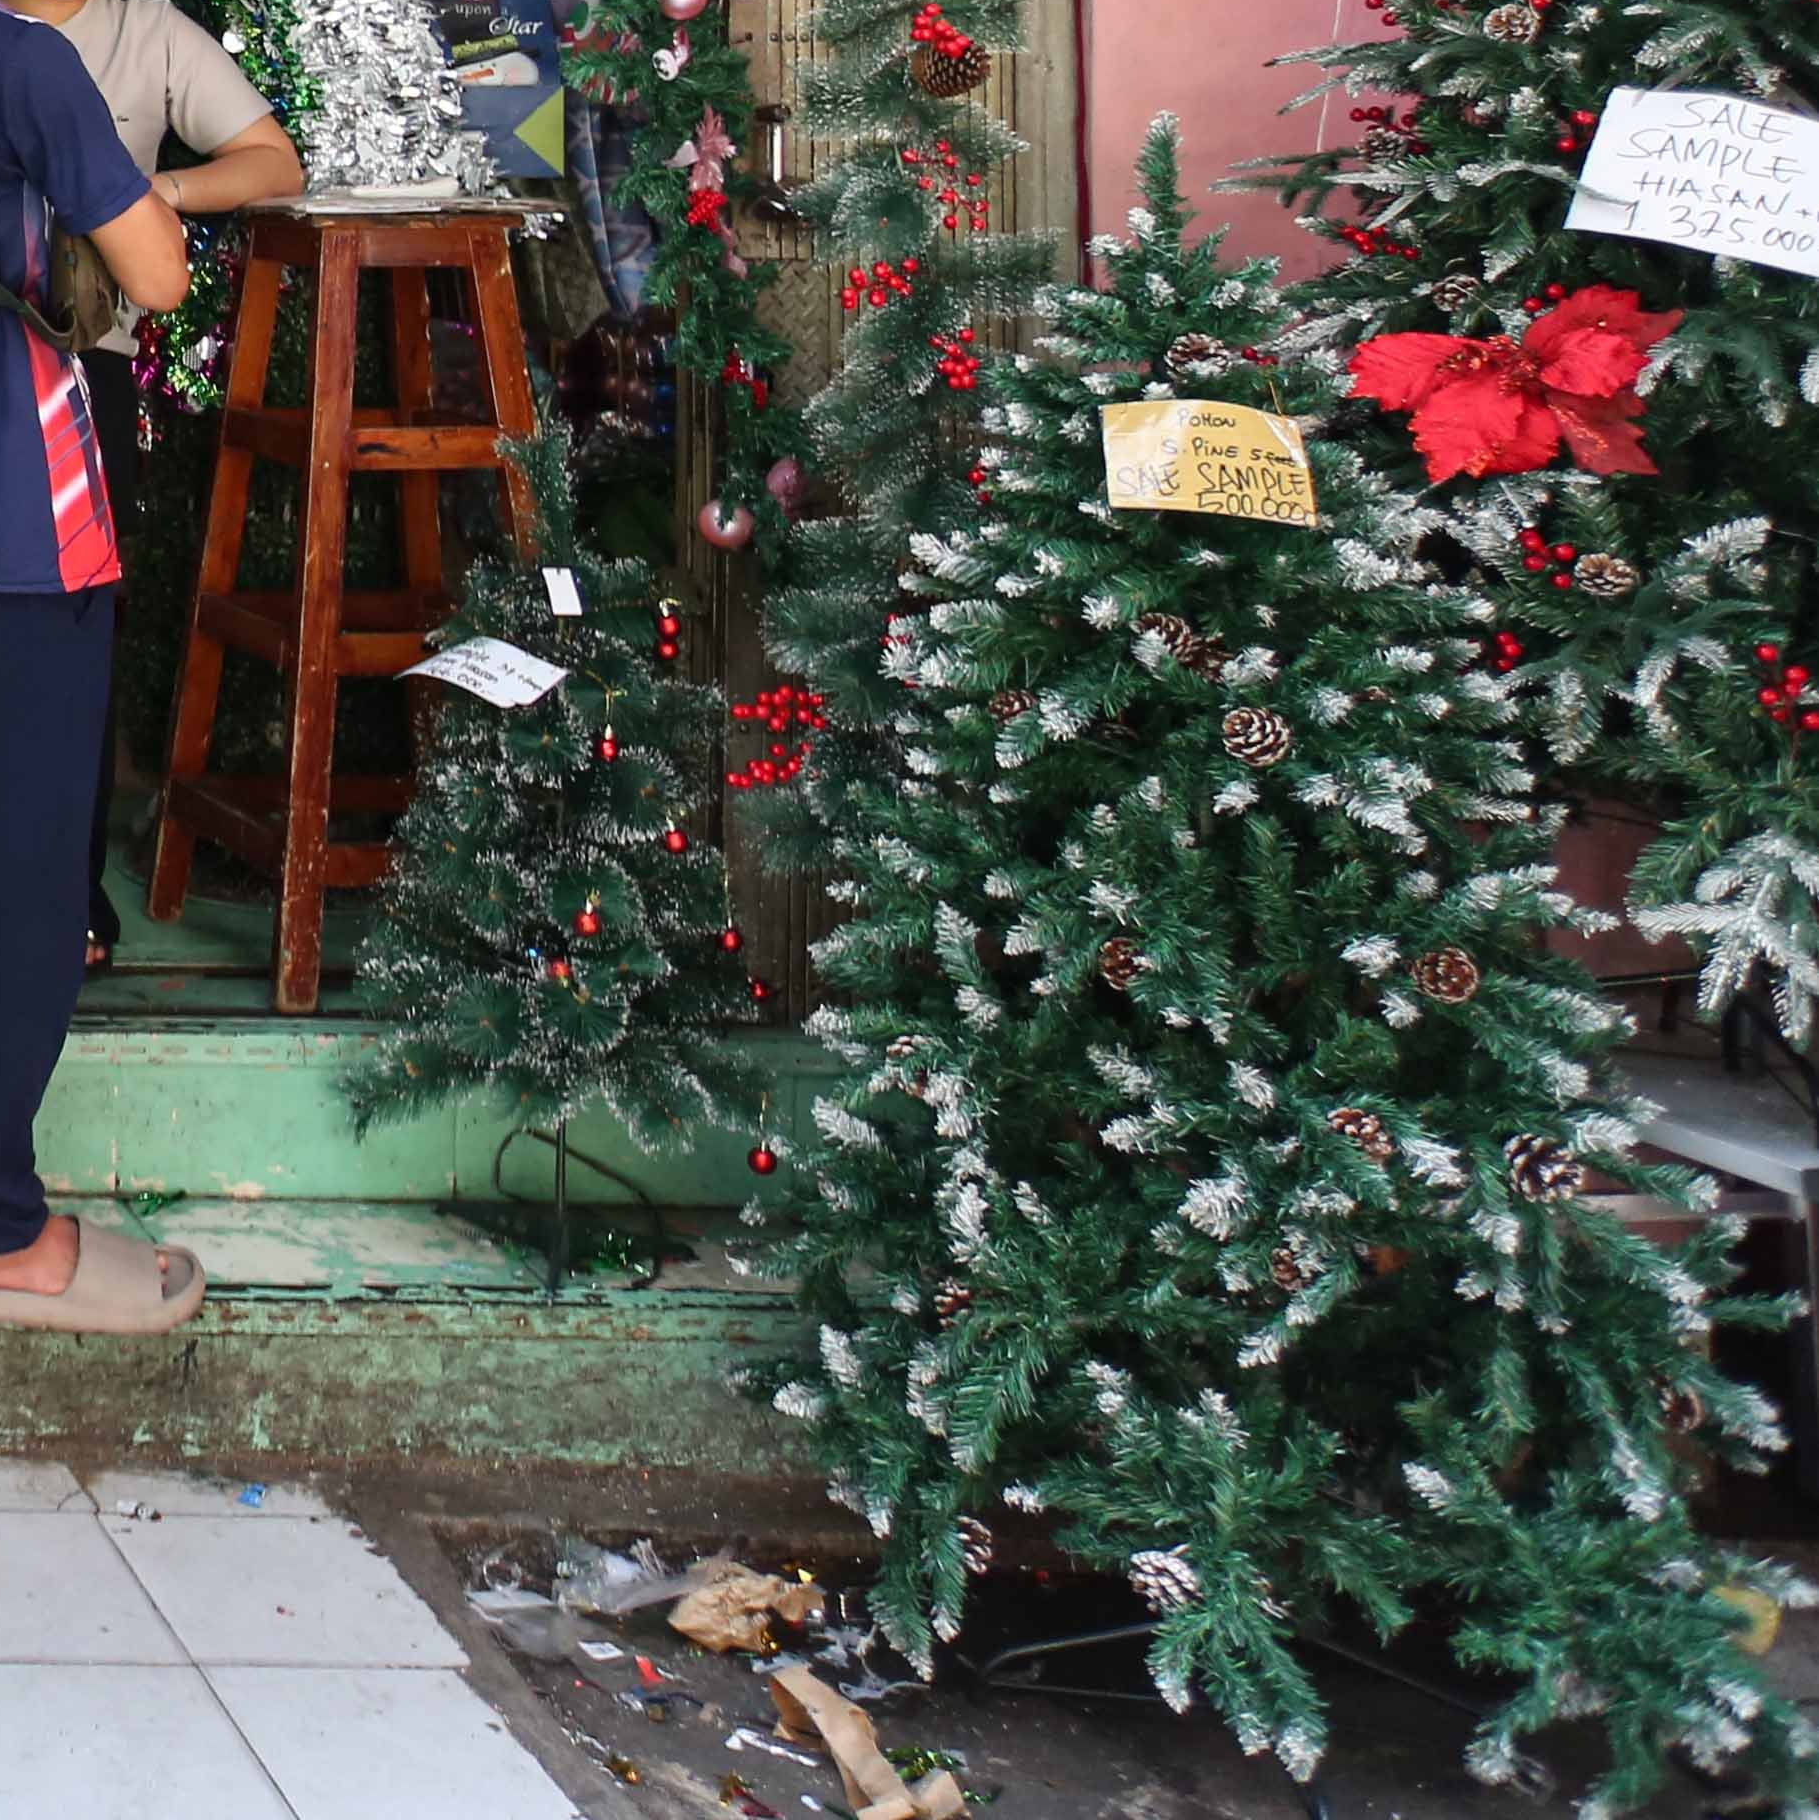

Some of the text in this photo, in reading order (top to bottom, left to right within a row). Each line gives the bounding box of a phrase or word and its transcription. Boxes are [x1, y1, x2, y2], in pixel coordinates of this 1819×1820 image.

[455, 2, 493, 19] upon
[1664, 97, 1794, 144] SALE
[1616, 128, 1807, 184] SAMPLE
[1632, 171, 1792, 216] HIASAN
[1197, 461, 1307, 497] SAMPLE
